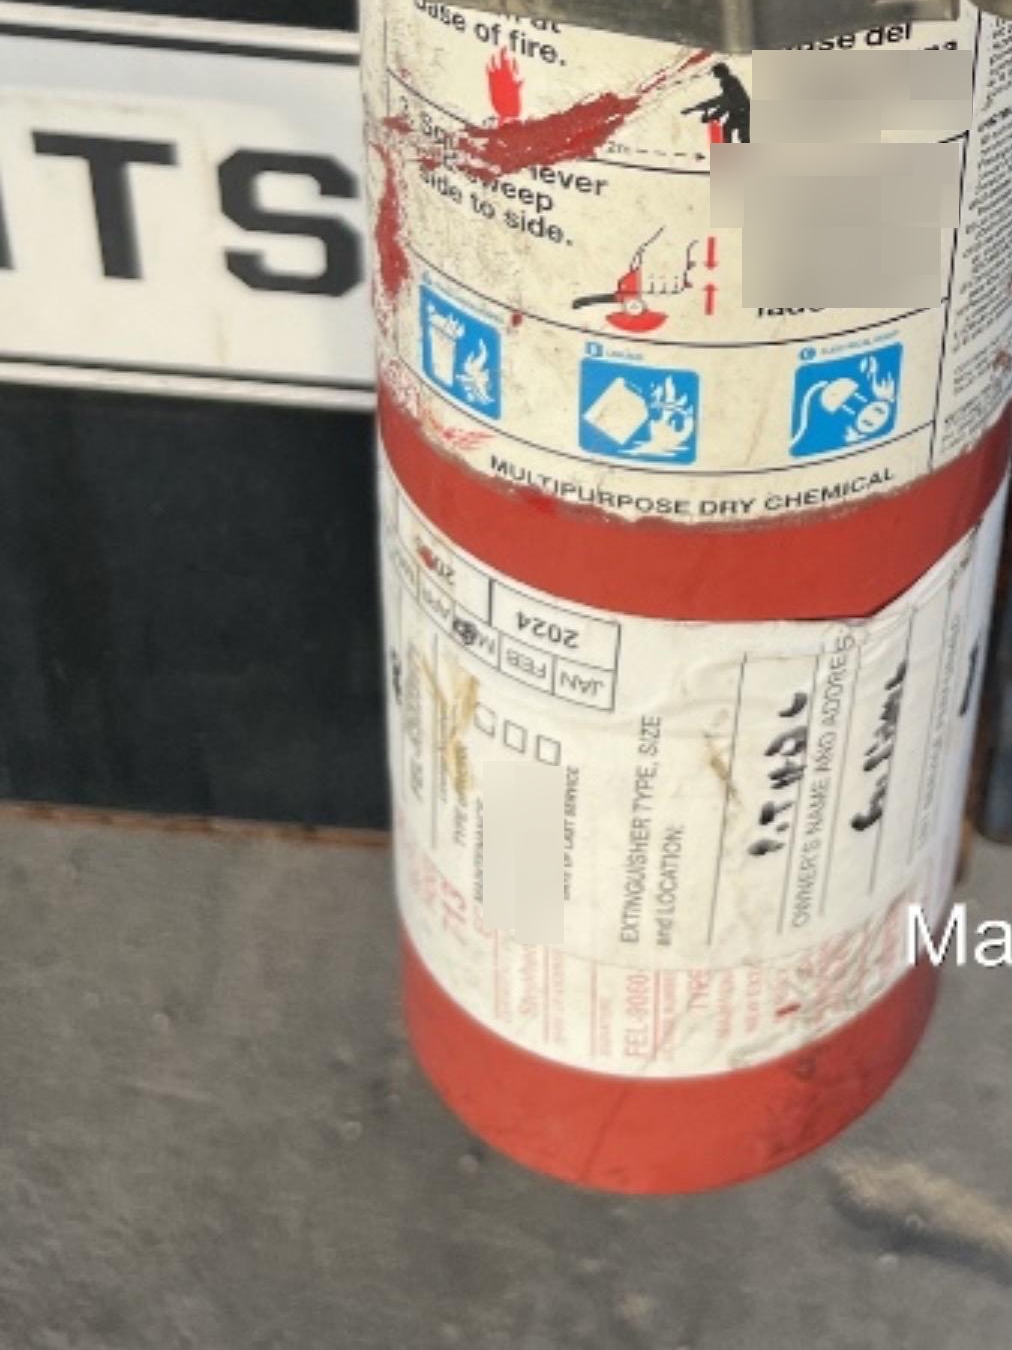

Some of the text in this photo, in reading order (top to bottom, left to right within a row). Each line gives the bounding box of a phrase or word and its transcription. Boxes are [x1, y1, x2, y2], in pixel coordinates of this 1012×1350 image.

[473, 18, 502, 44] of
[509, 29, 567, 67] fire.
[0, 129, 365, 298] TS
[470, 192, 496, 220] to
[503, 208, 573, 247] side.
[489, 453, 897, 516] MULTIPURPOSE DRY CHEMICAL
[516, 610, 579, 650] 2024
[505, 648, 547, 679] FEB
[560, 670, 604, 697] JAN
[619, 816, 651, 944] EXTINGUISHER
[638, 714, 662, 757] SIZE
